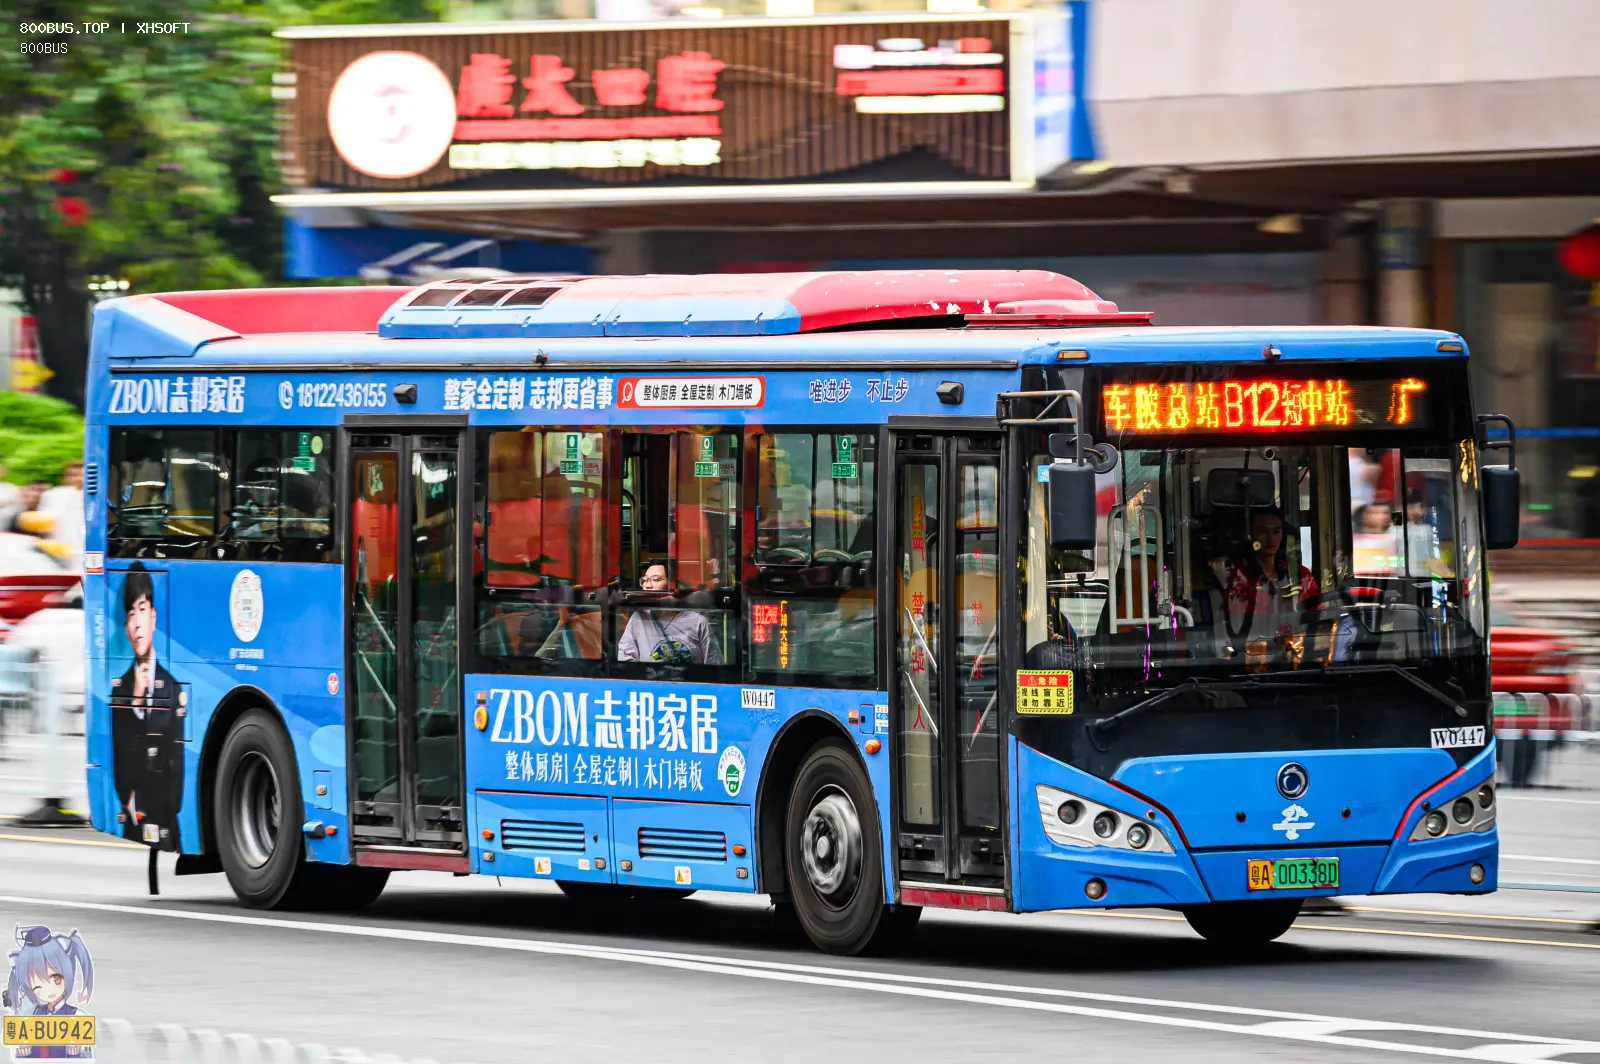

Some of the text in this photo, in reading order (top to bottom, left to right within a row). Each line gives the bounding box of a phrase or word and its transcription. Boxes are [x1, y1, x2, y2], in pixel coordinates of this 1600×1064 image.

[297, 382, 387, 408] 18122436155
[443, 376, 614, 411] 整家全定制 志邦更省事
[643, 383, 753, 401] 整体厨房 全屋定制 木门墙板
[809, 378, 909, 403] 唯进步 不止步
[1038, 676, 1058, 686] 危险
[742, 690, 774, 707] W0447
[1021, 688, 1065, 698] 视线盲区
[1021, 699, 1065, 708] 请勿靠近
[1432, 728, 1484, 747] W0447
[643, 757, 704, 792] 木门墙板
